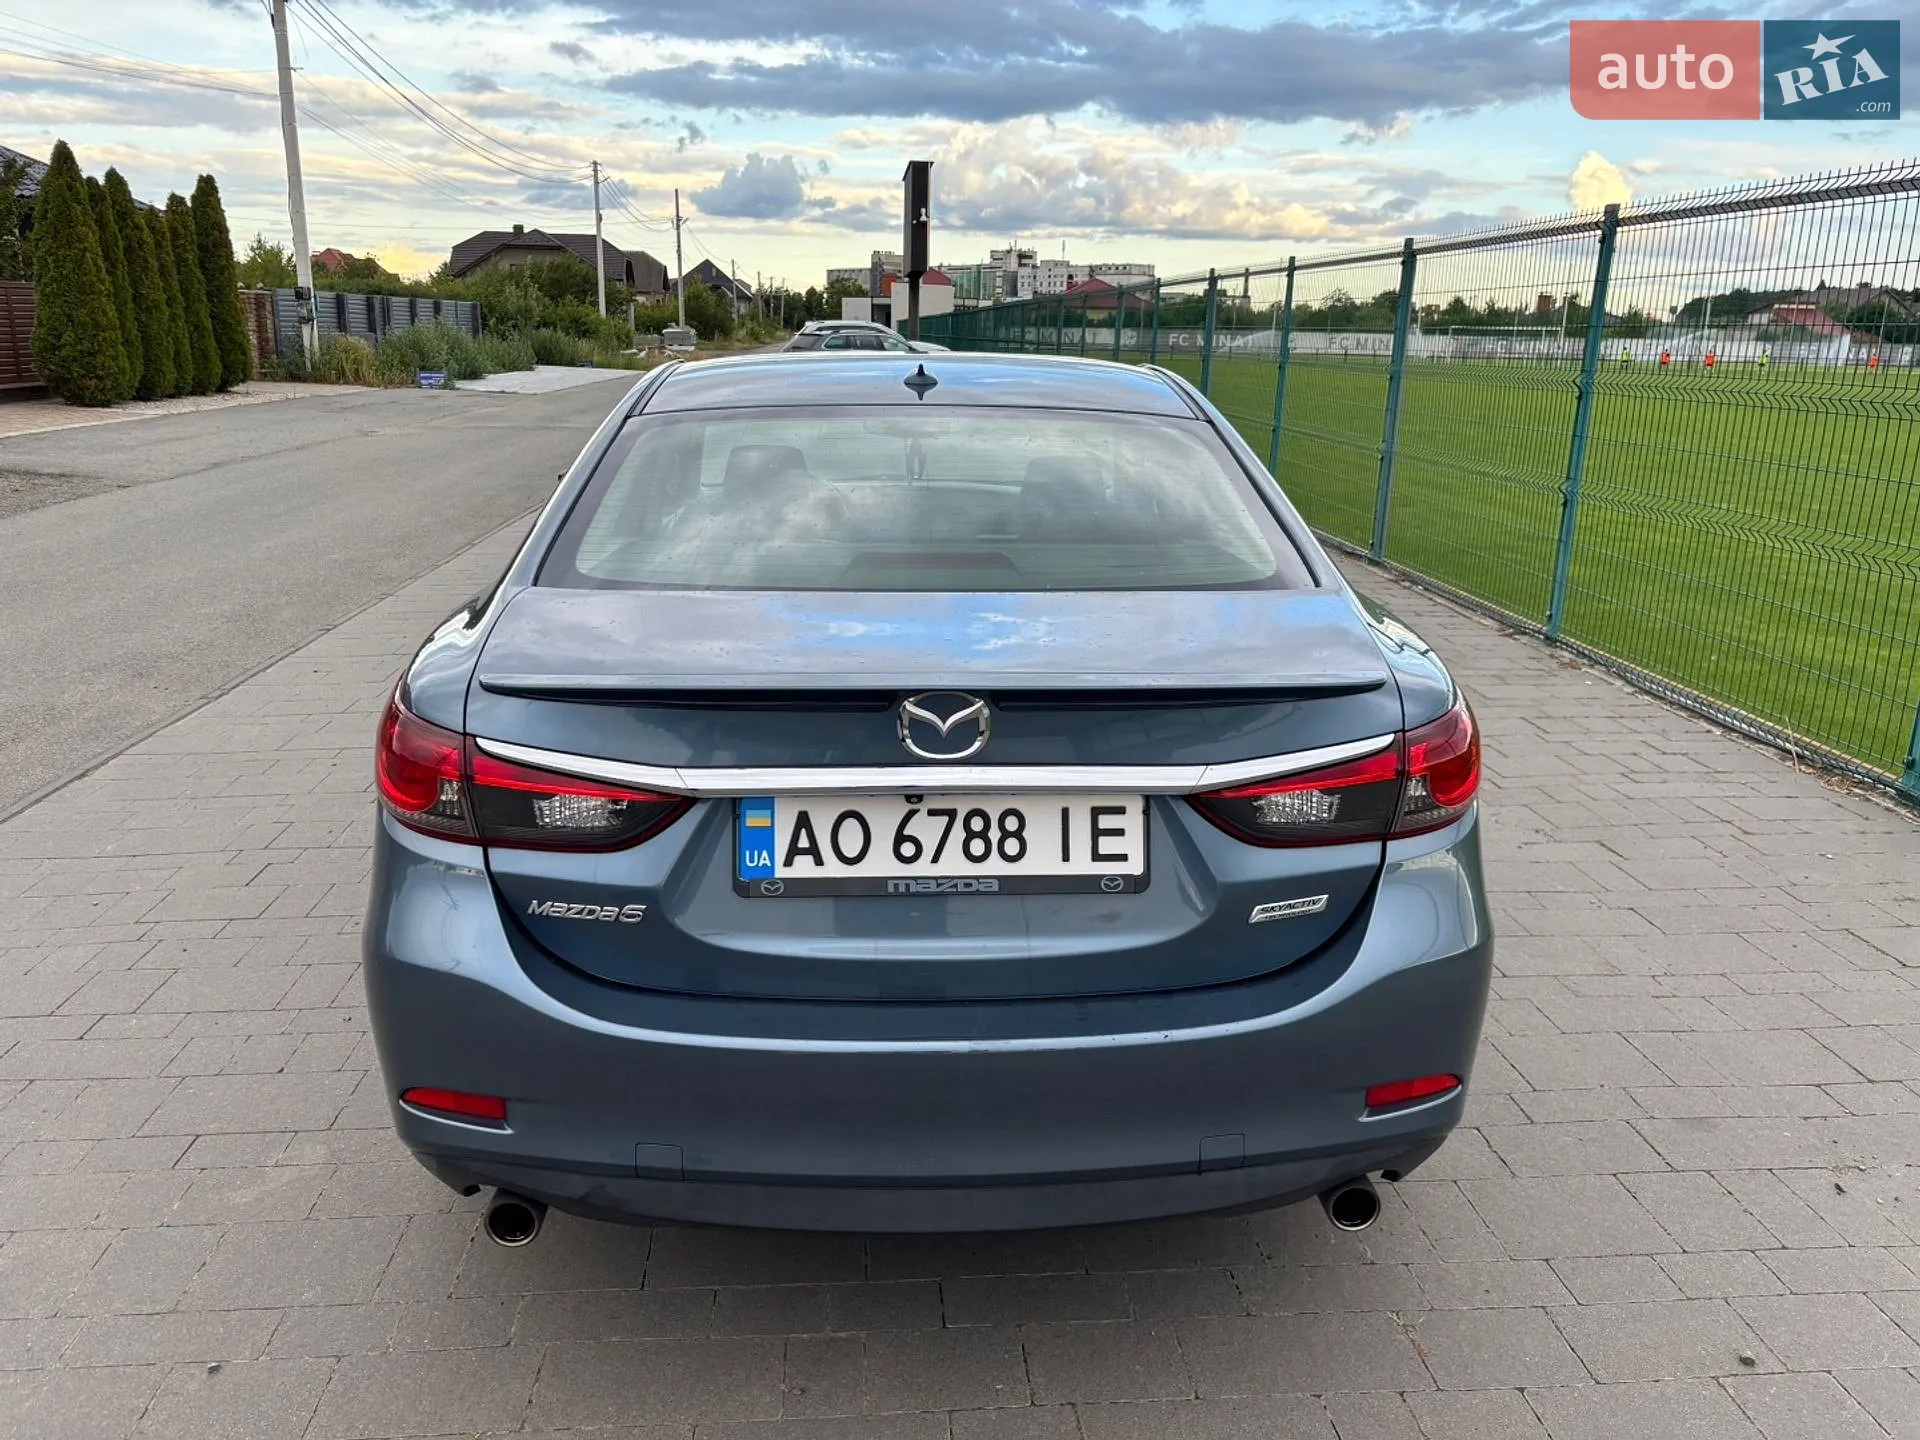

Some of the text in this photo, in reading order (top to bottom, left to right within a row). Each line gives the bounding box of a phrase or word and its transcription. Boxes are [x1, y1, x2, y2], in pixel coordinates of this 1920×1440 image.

[1168, 333, 1189, 346] FC
[782, 805, 1129, 867] AO 6788 IE
[745, 849, 772, 868] UA
[1260, 897, 1321, 913] SKYACTIV
